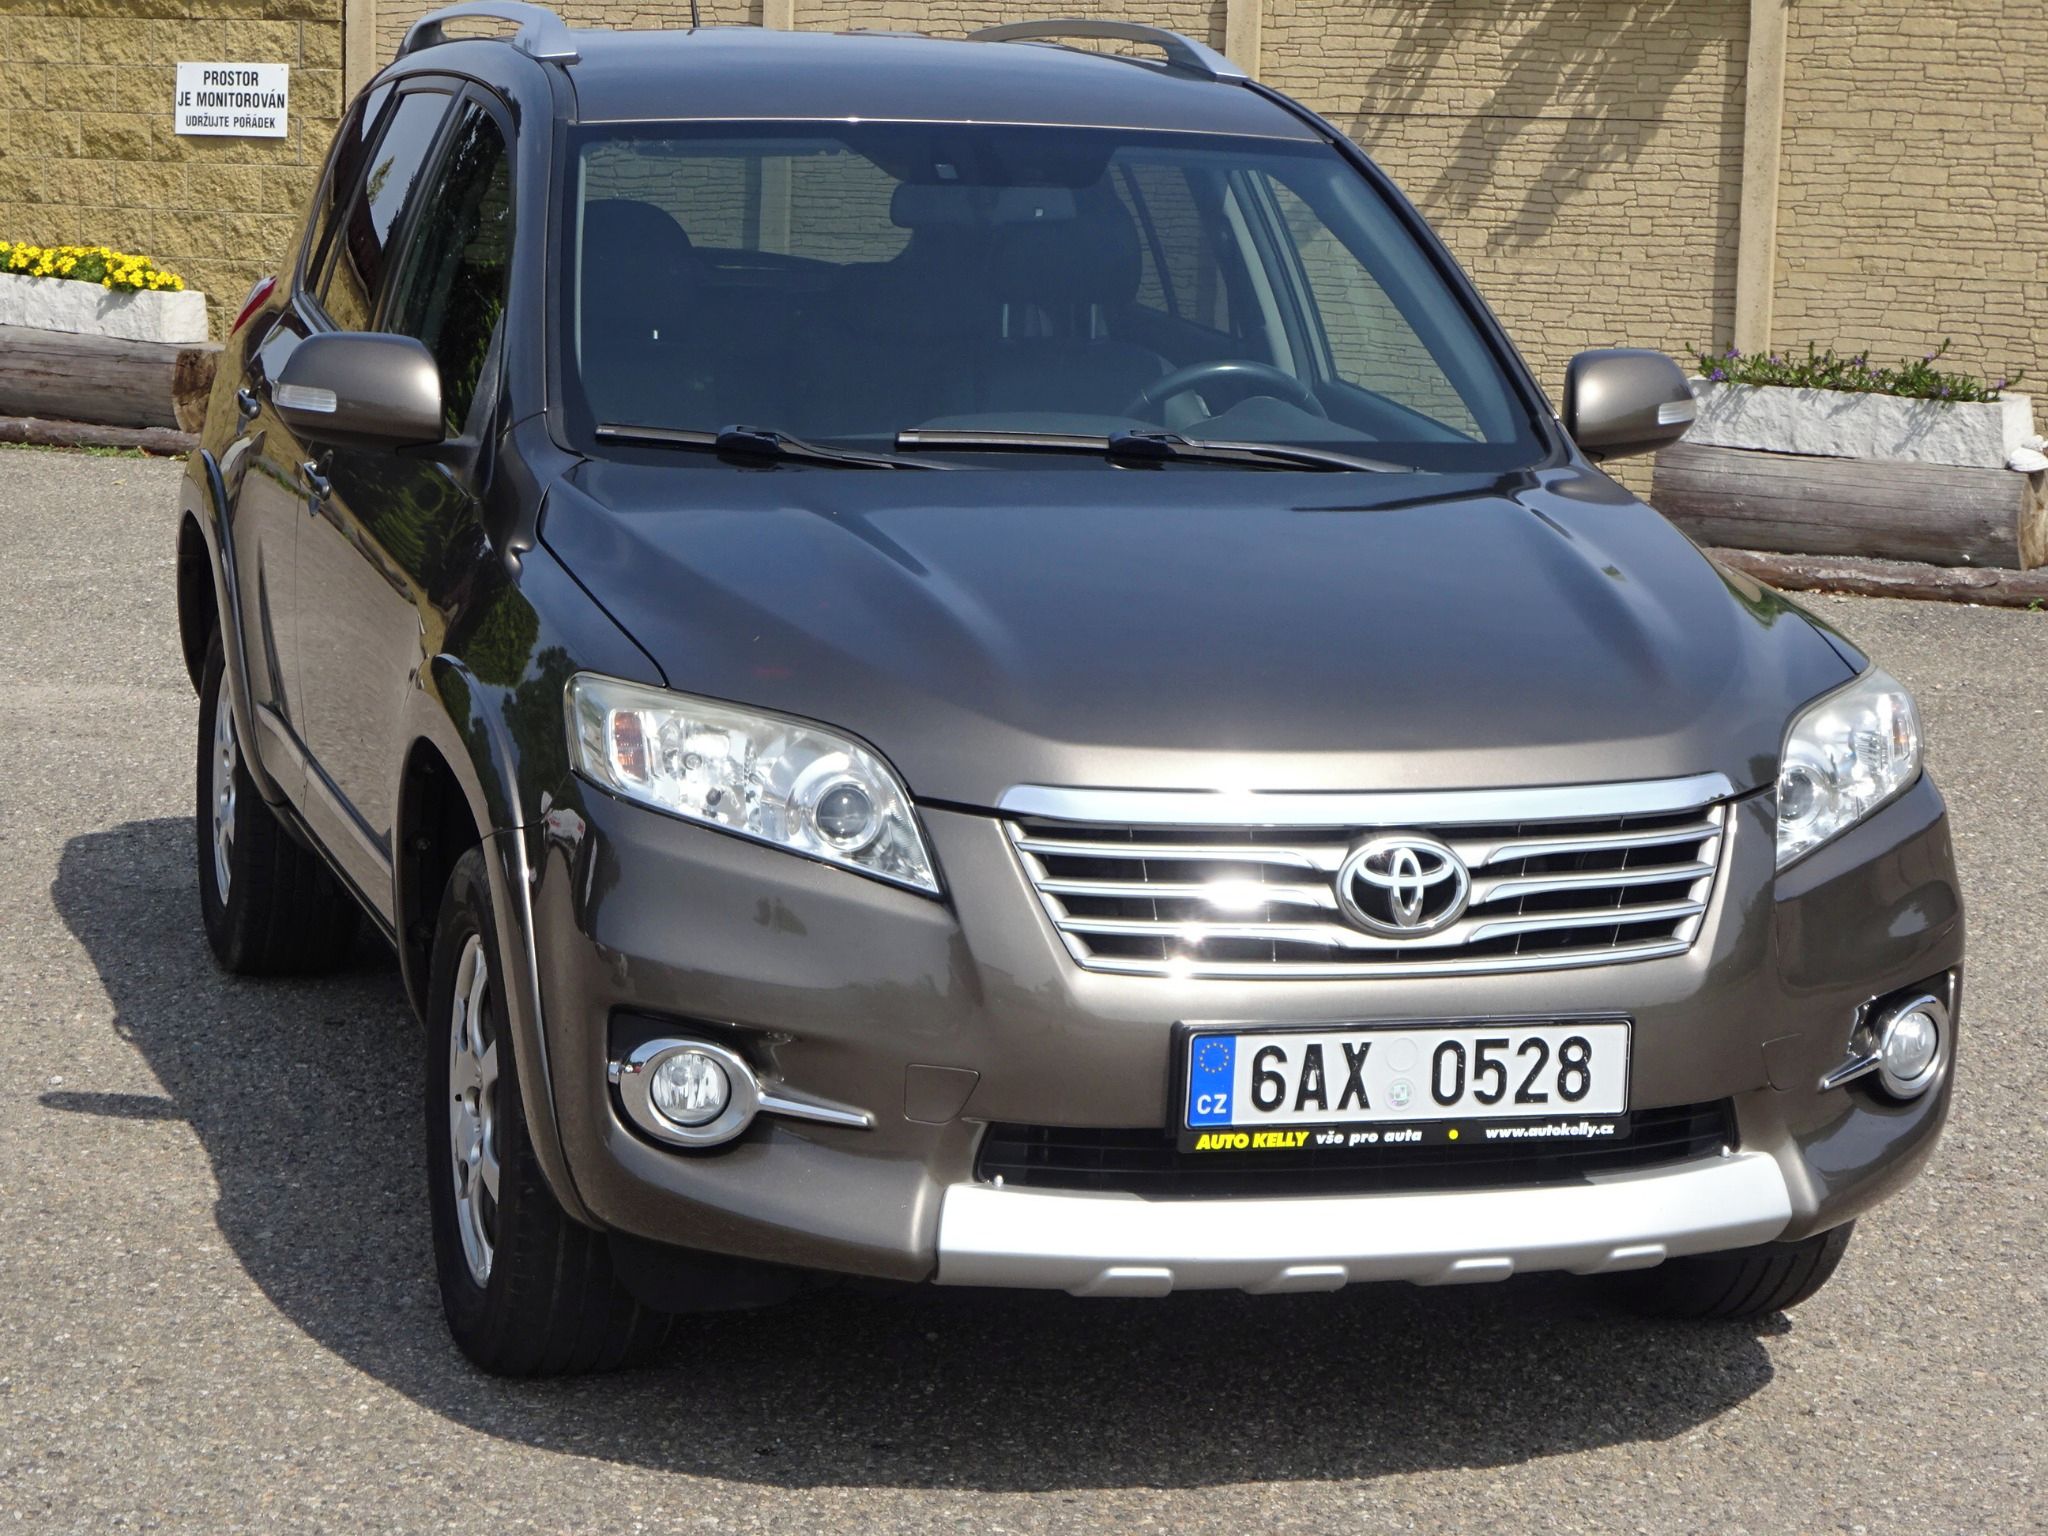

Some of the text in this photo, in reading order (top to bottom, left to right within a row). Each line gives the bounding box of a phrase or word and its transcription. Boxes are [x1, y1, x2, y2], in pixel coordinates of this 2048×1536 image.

[203, 70, 259, 87] PROSTOR
[178, 88, 285, 109] JE MONITOROVÁN
[185, 113, 275, 128] UDRŽUJTE POŘÁDEK
[1251, 1036, 1592, 1112] 6AX 0528
[1197, 1093, 1227, 1114] CZ
[1196, 1122, 1615, 1150] AUTO KELLY vše pro auta www.autokelly.cz
